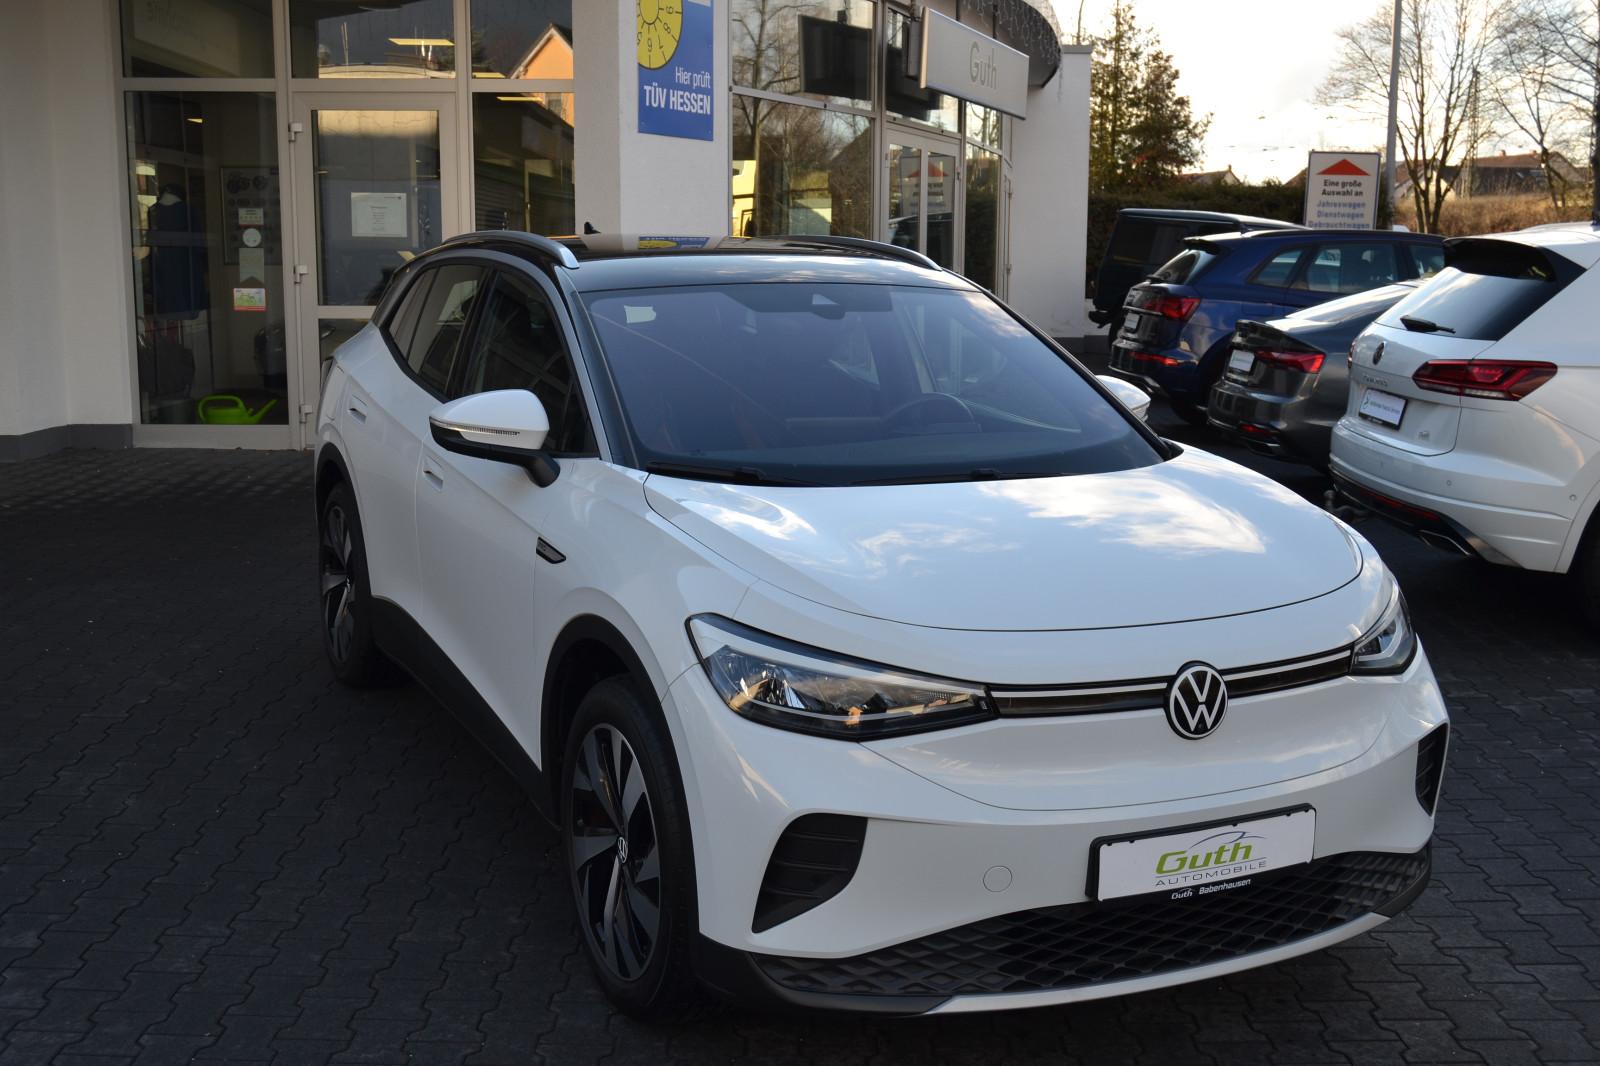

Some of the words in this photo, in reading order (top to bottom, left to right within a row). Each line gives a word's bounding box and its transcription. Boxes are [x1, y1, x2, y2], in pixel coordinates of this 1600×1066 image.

[675, 66, 691, 85] Hier
[693, 72, 711, 89] prüft
[970, 42, 997, 89] Guth
[643, 82, 667, 108] TÜV
[669, 89, 711, 115] HESSEN
[1323, 179, 1339, 187] Eine
[1341, 179, 1362, 188] große
[1154, 842, 1253, 874] Guth
[1155, 861, 1266, 887] AUTOMOBILE
[1172, 887, 1192, 900] Guth
[1199, 879, 1252, 895] Babenhausen
